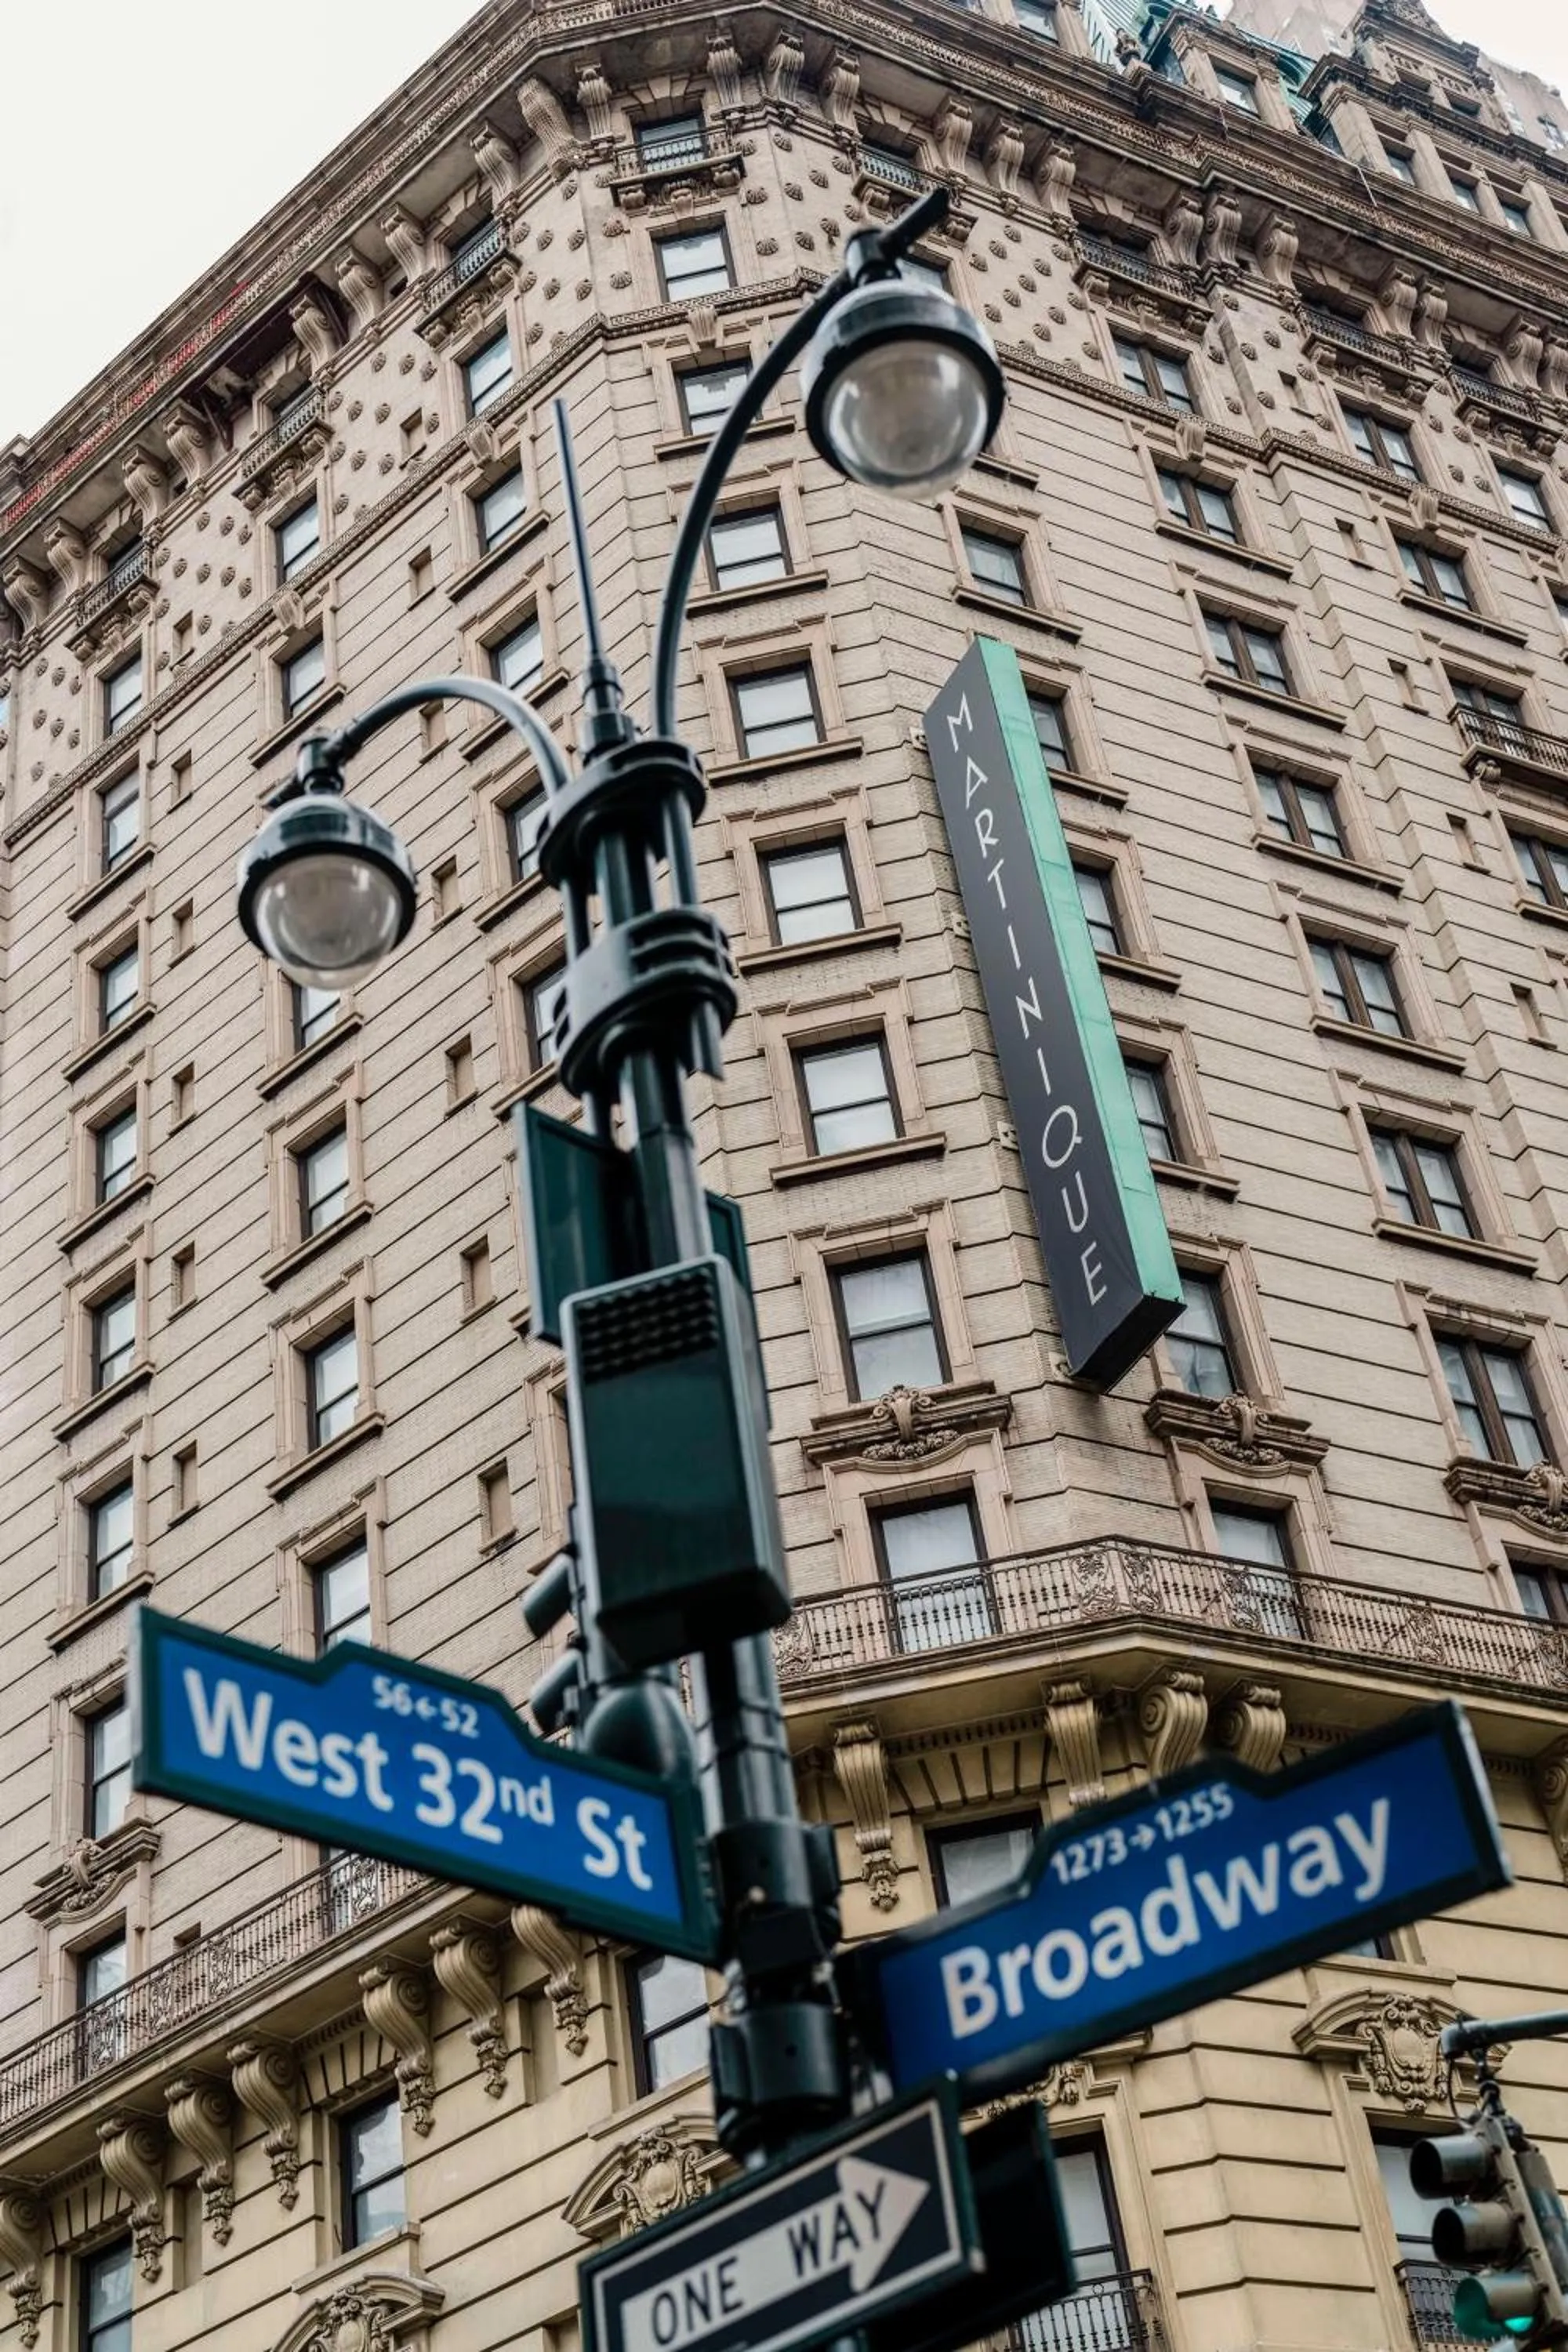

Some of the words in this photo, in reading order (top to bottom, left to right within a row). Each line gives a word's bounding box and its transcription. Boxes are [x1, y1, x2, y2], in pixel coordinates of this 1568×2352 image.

[946, 691, 1107, 1305] MARTINIQUE
[183, 1667, 394, 1812] West
[412, 1744, 554, 1844] 32nd
[576, 1797, 653, 1890] St
[372, 1675, 413, 1715] 56
[441, 1699, 480, 1738] 52
[940, 1797, 1390, 2040] Broadway
[1051, 1828, 1127, 1885] 1273
[1156, 1782, 1235, 1838] 1255
[652, 2256, 743, 2347] ONE
[787, 2180, 885, 2278] WAY
